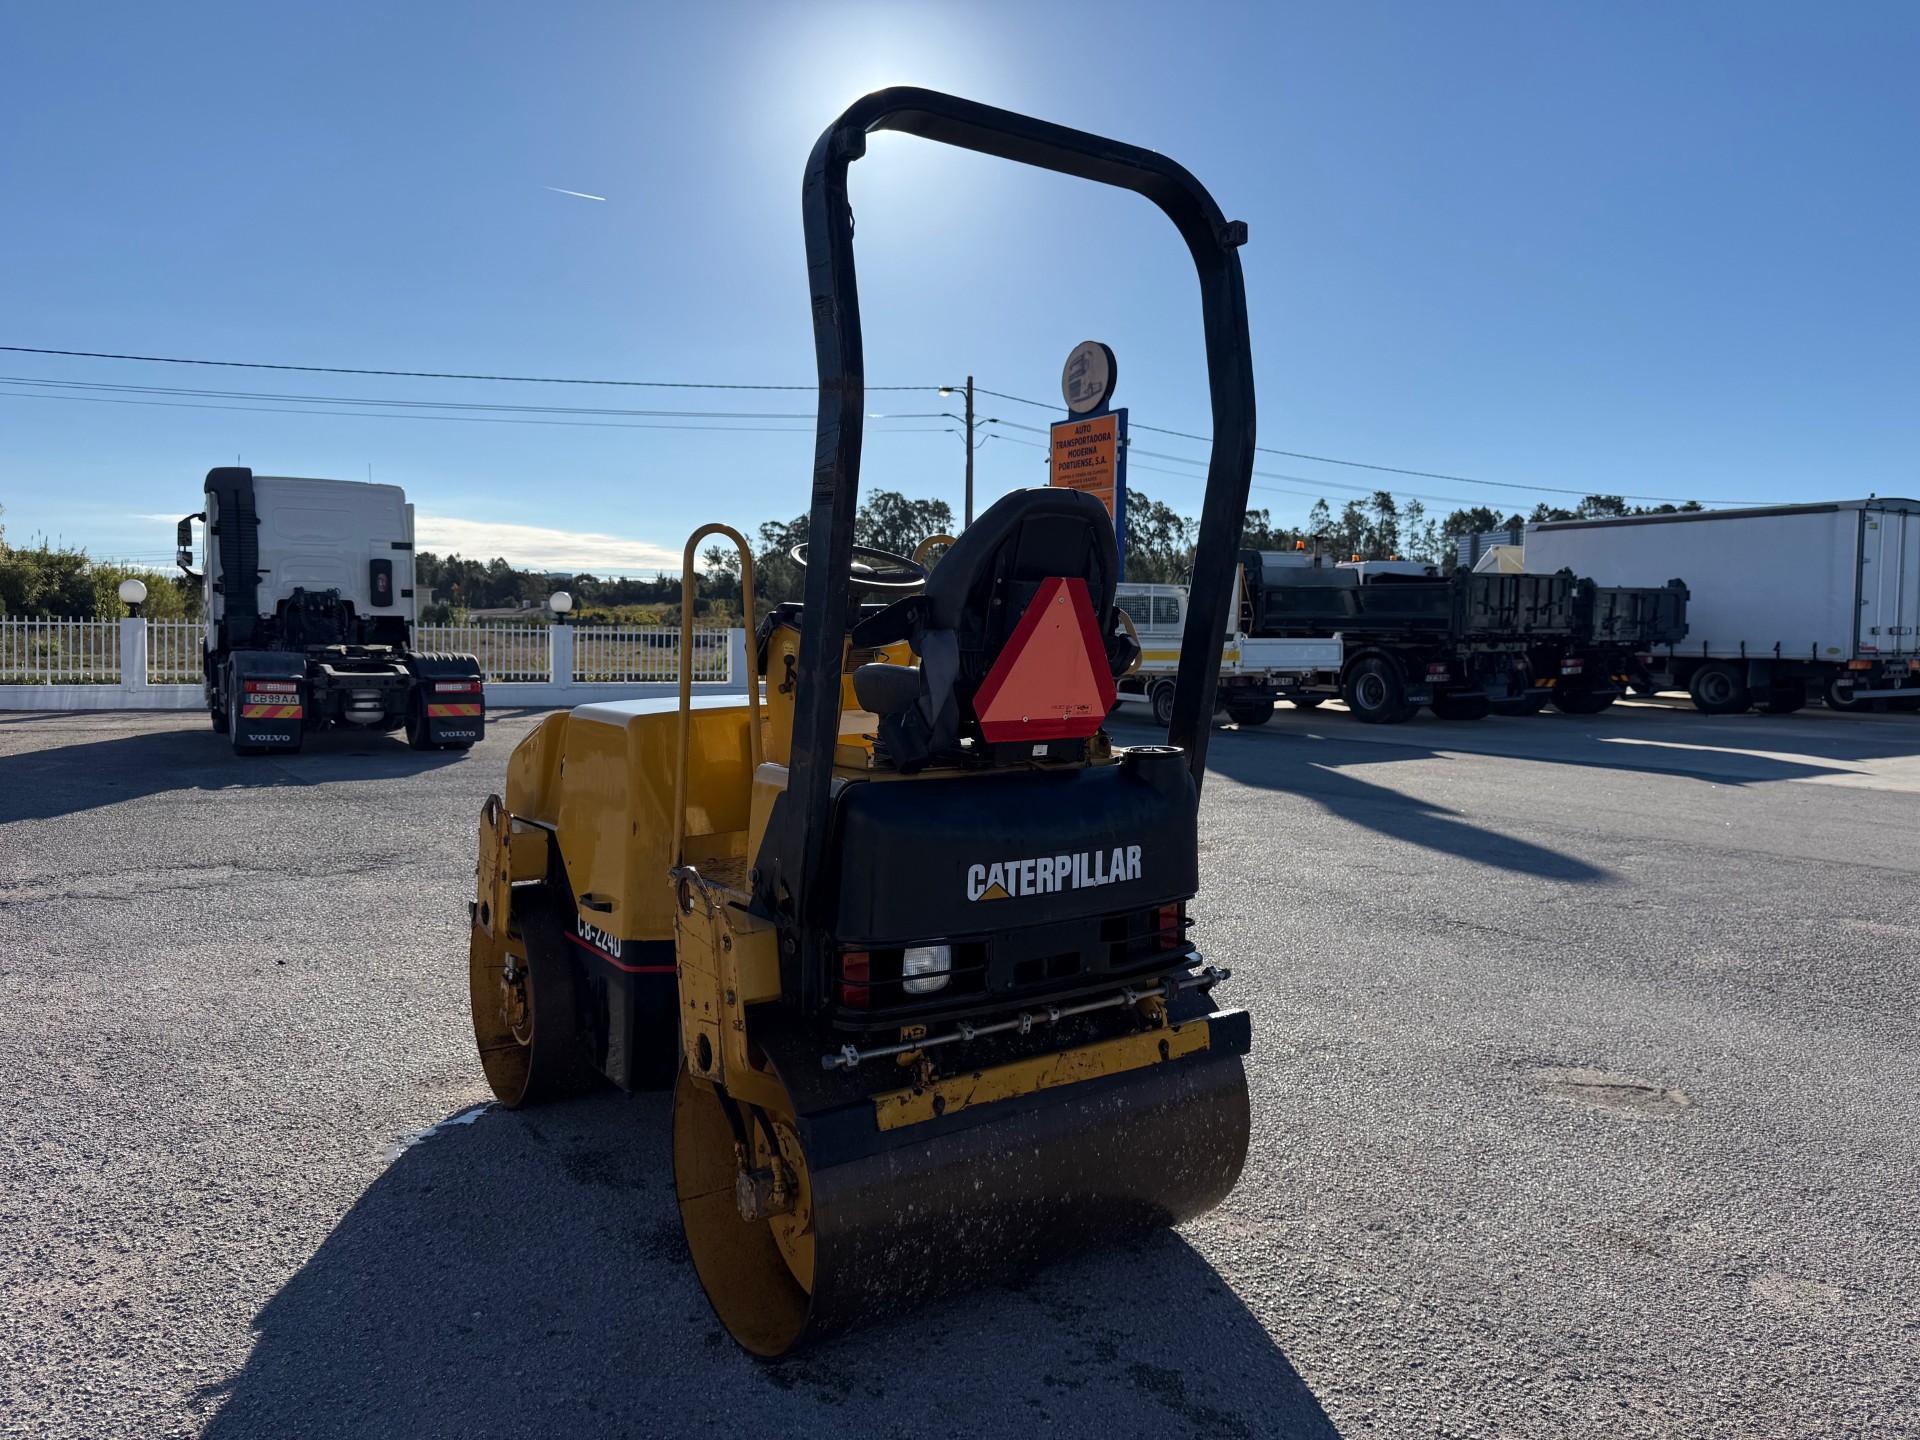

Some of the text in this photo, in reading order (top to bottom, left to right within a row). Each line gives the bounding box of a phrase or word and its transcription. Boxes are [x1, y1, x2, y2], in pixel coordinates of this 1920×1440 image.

[1075, 424, 1091, 435] AUTO
[1056, 432, 1111, 450] TRANSPORTADORA
[1067, 446, 1097, 459] MODERNA
[1058, 456, 1107, 471] PORTUENSE, S.A.
[248, 734, 290, 742] VOLVO
[967, 845, 1142, 902] CATERPILLAR
